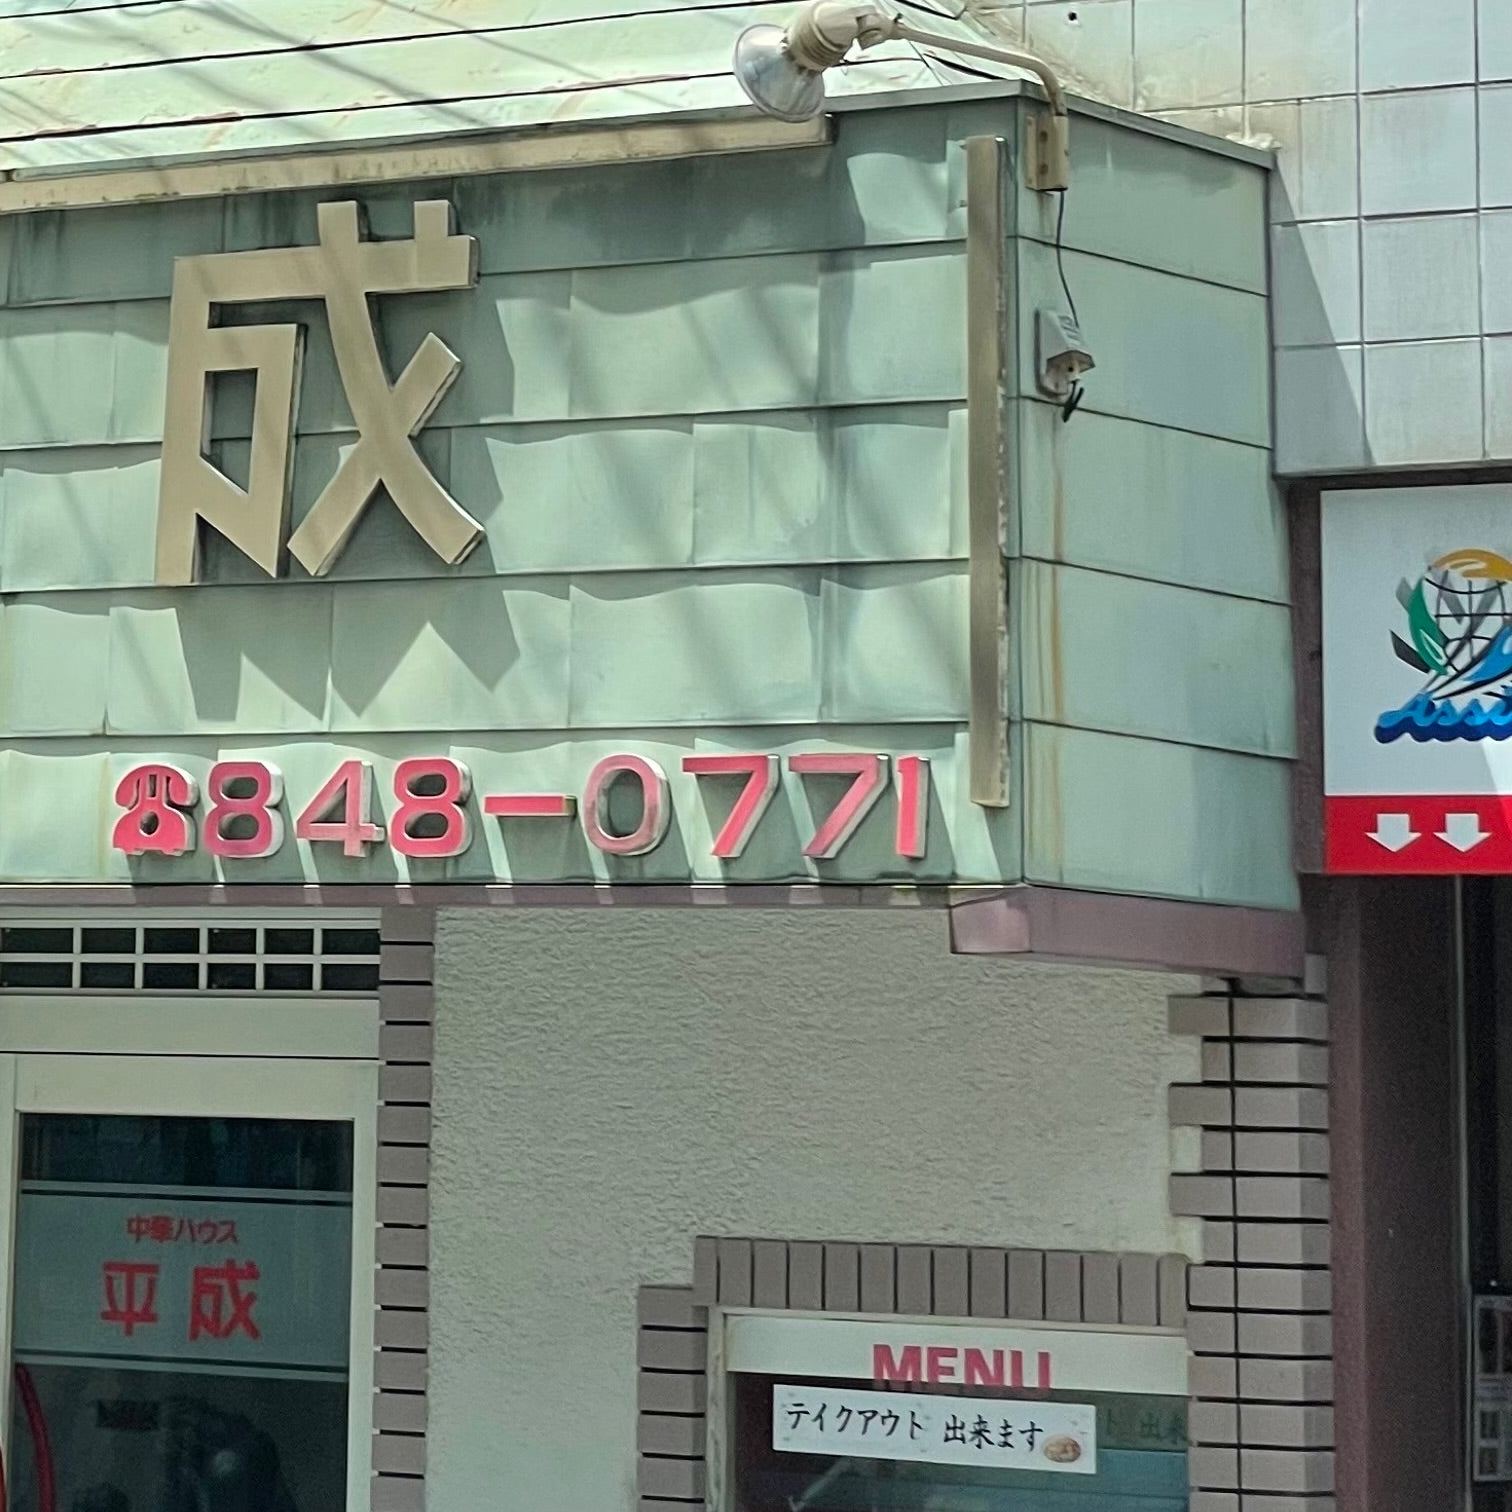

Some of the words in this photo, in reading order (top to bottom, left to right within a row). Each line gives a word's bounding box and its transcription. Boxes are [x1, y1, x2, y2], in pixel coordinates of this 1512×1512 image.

[127, 1214, 238, 1244] 中華ハウス
[101, 1259, 260, 1341] 平成
[872, 1343, 1053, 1400] MENU
[787, 1402, 924, 1440] テイクアウト
[943, 1413, 1044, 1452] 出来ます
